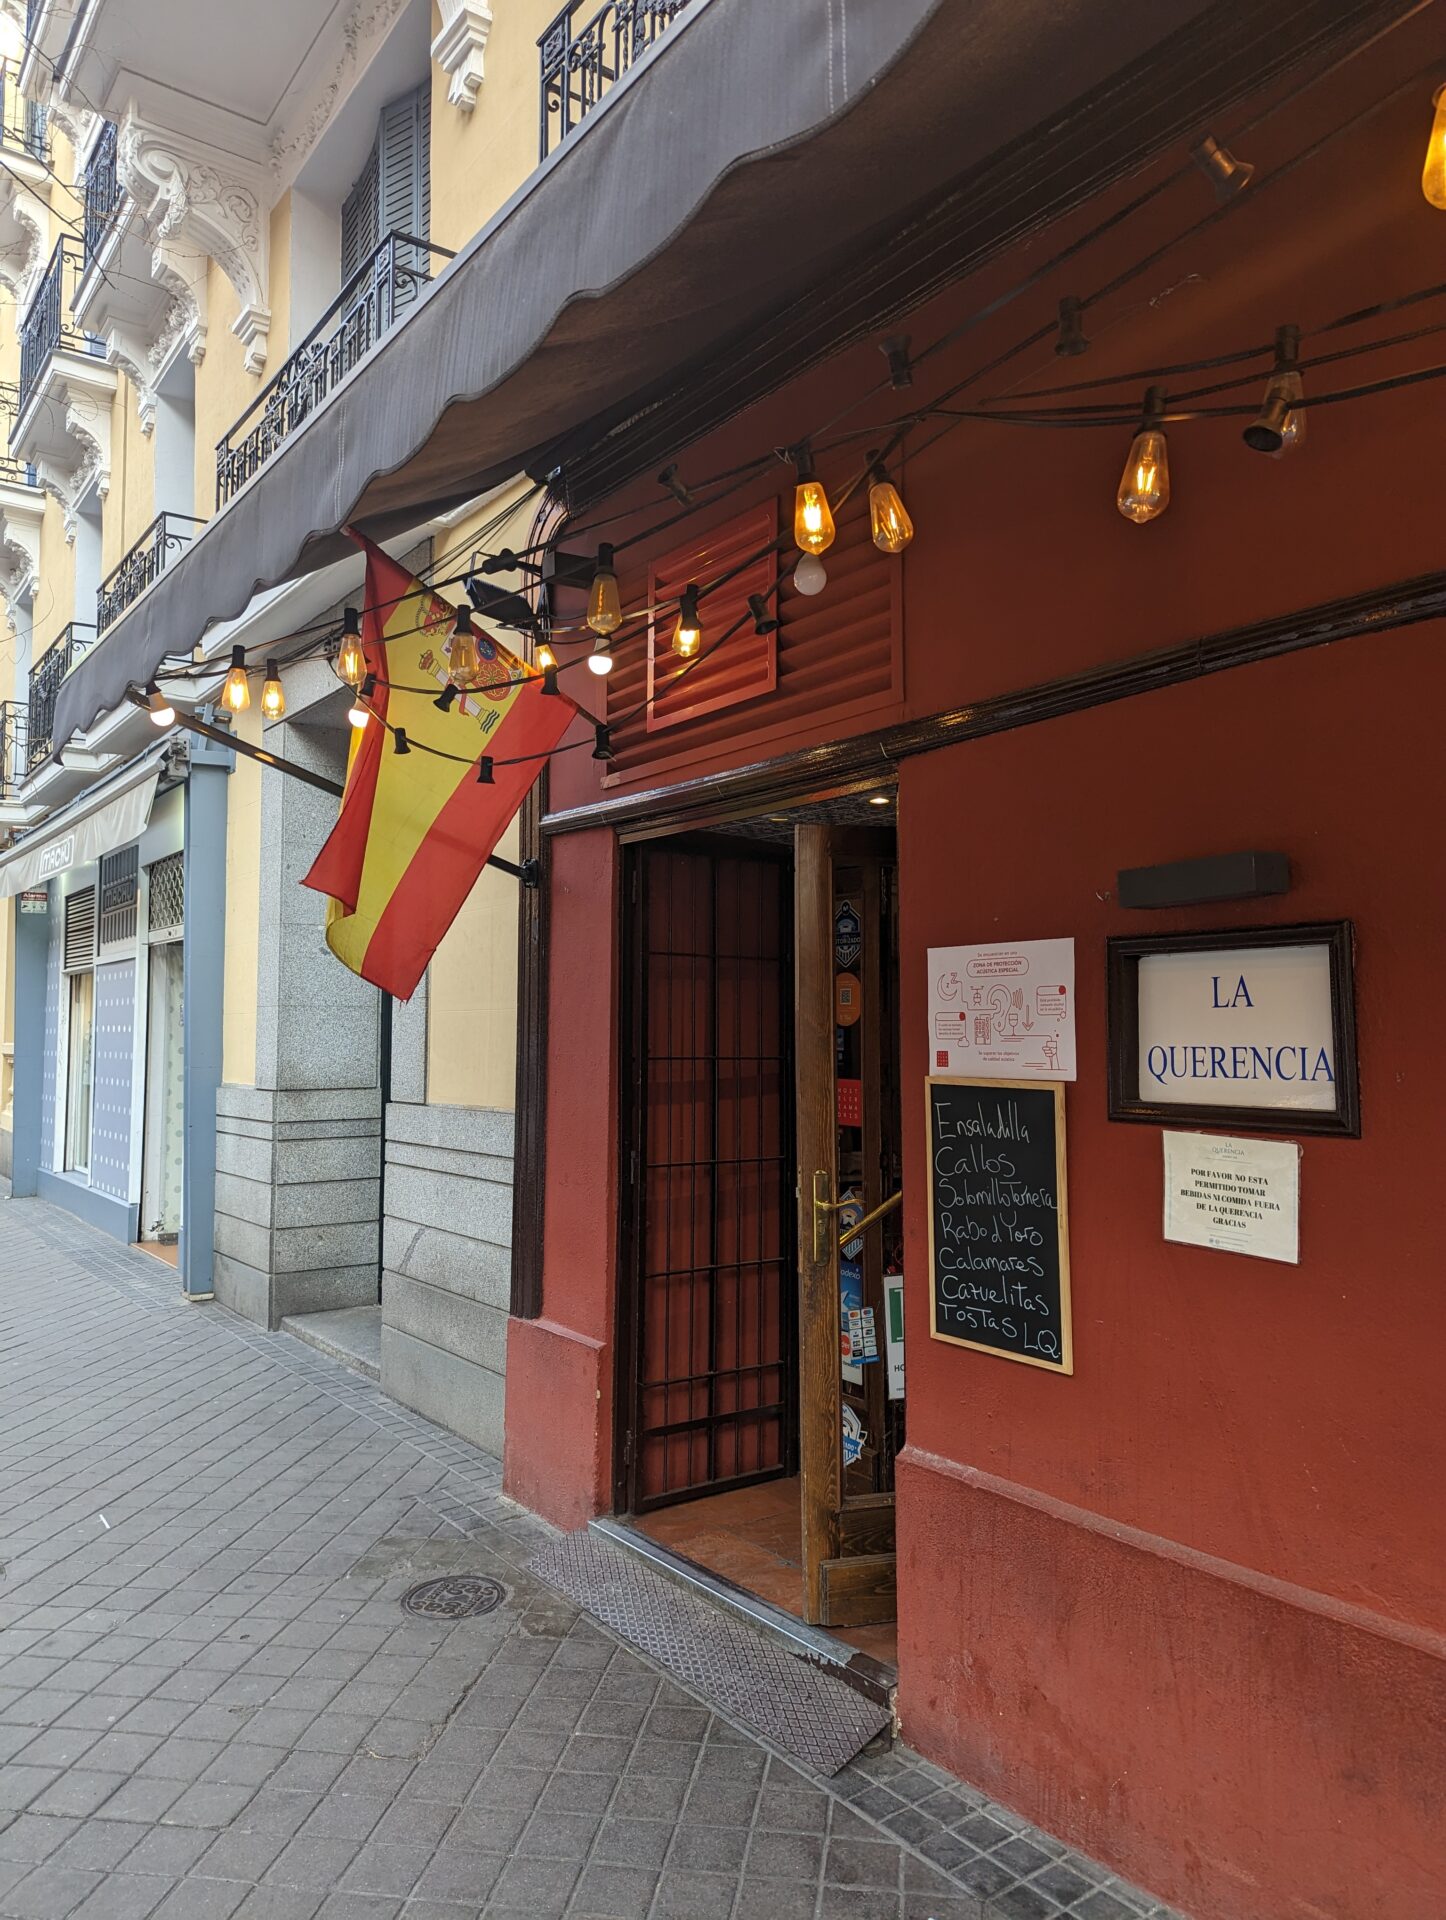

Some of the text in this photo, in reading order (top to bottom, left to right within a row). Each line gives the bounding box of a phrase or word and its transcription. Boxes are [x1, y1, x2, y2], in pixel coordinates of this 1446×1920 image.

[993, 960, 1022, 968] PROTECCIÓN
[1211, 974, 1254, 1009] LA
[1147, 1045, 1336, 1086] QUERENCIA
[934, 1100, 1030, 1143] Ensaladilla
[935, 1143, 1015, 1178] Callos
[1190, 1168, 1268, 1186] POR FAVOR NO ESTA
[1195, 1180, 1266, 1197] PERMITIDO TOMAR
[1180, 1188, 1281, 1211] BEBIDAS NI COMIDA FUERA
[1196, 1202, 1263, 1220] DE LA QUERENCIA
[941, 1212, 987, 1245] Rabo
[1212, 1216, 1247, 1229] GRACIAS
[840, 1268, 861, 1280] odexo
[938, 1246, 1044, 1277] Calamares
[941, 1274, 1050, 1316] Cazuelitas
